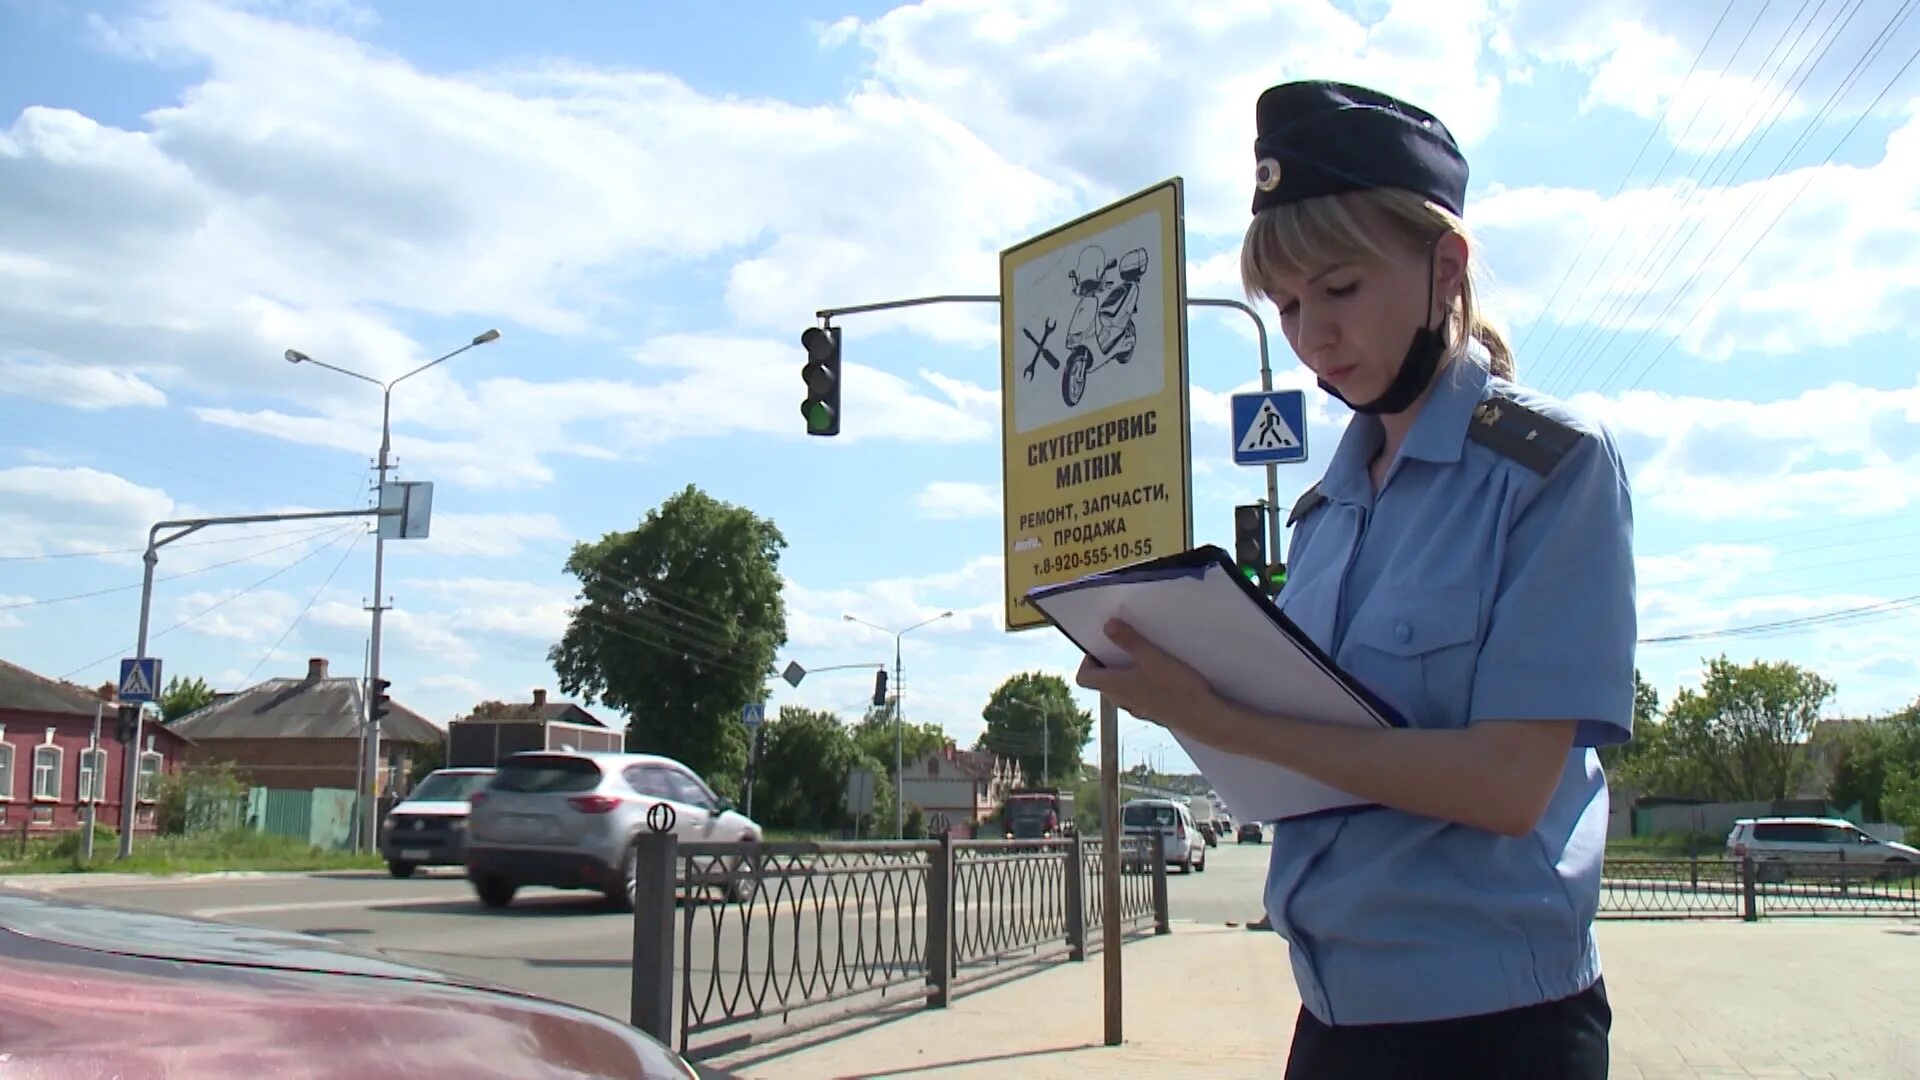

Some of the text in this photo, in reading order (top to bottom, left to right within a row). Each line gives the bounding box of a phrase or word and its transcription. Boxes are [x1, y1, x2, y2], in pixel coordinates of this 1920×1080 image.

[1027, 410, 1157, 467] СКУТЕРСЕРВИС
[1056, 451, 1122, 489] MATRIX
[1019, 483, 1169, 531] РЕМОНТ, ЗАПЧАСТИ,
[1054, 516, 1127, 547] ПРОДАЖА
[1033, 538, 1152, 577] т.8-920-555-10-55
